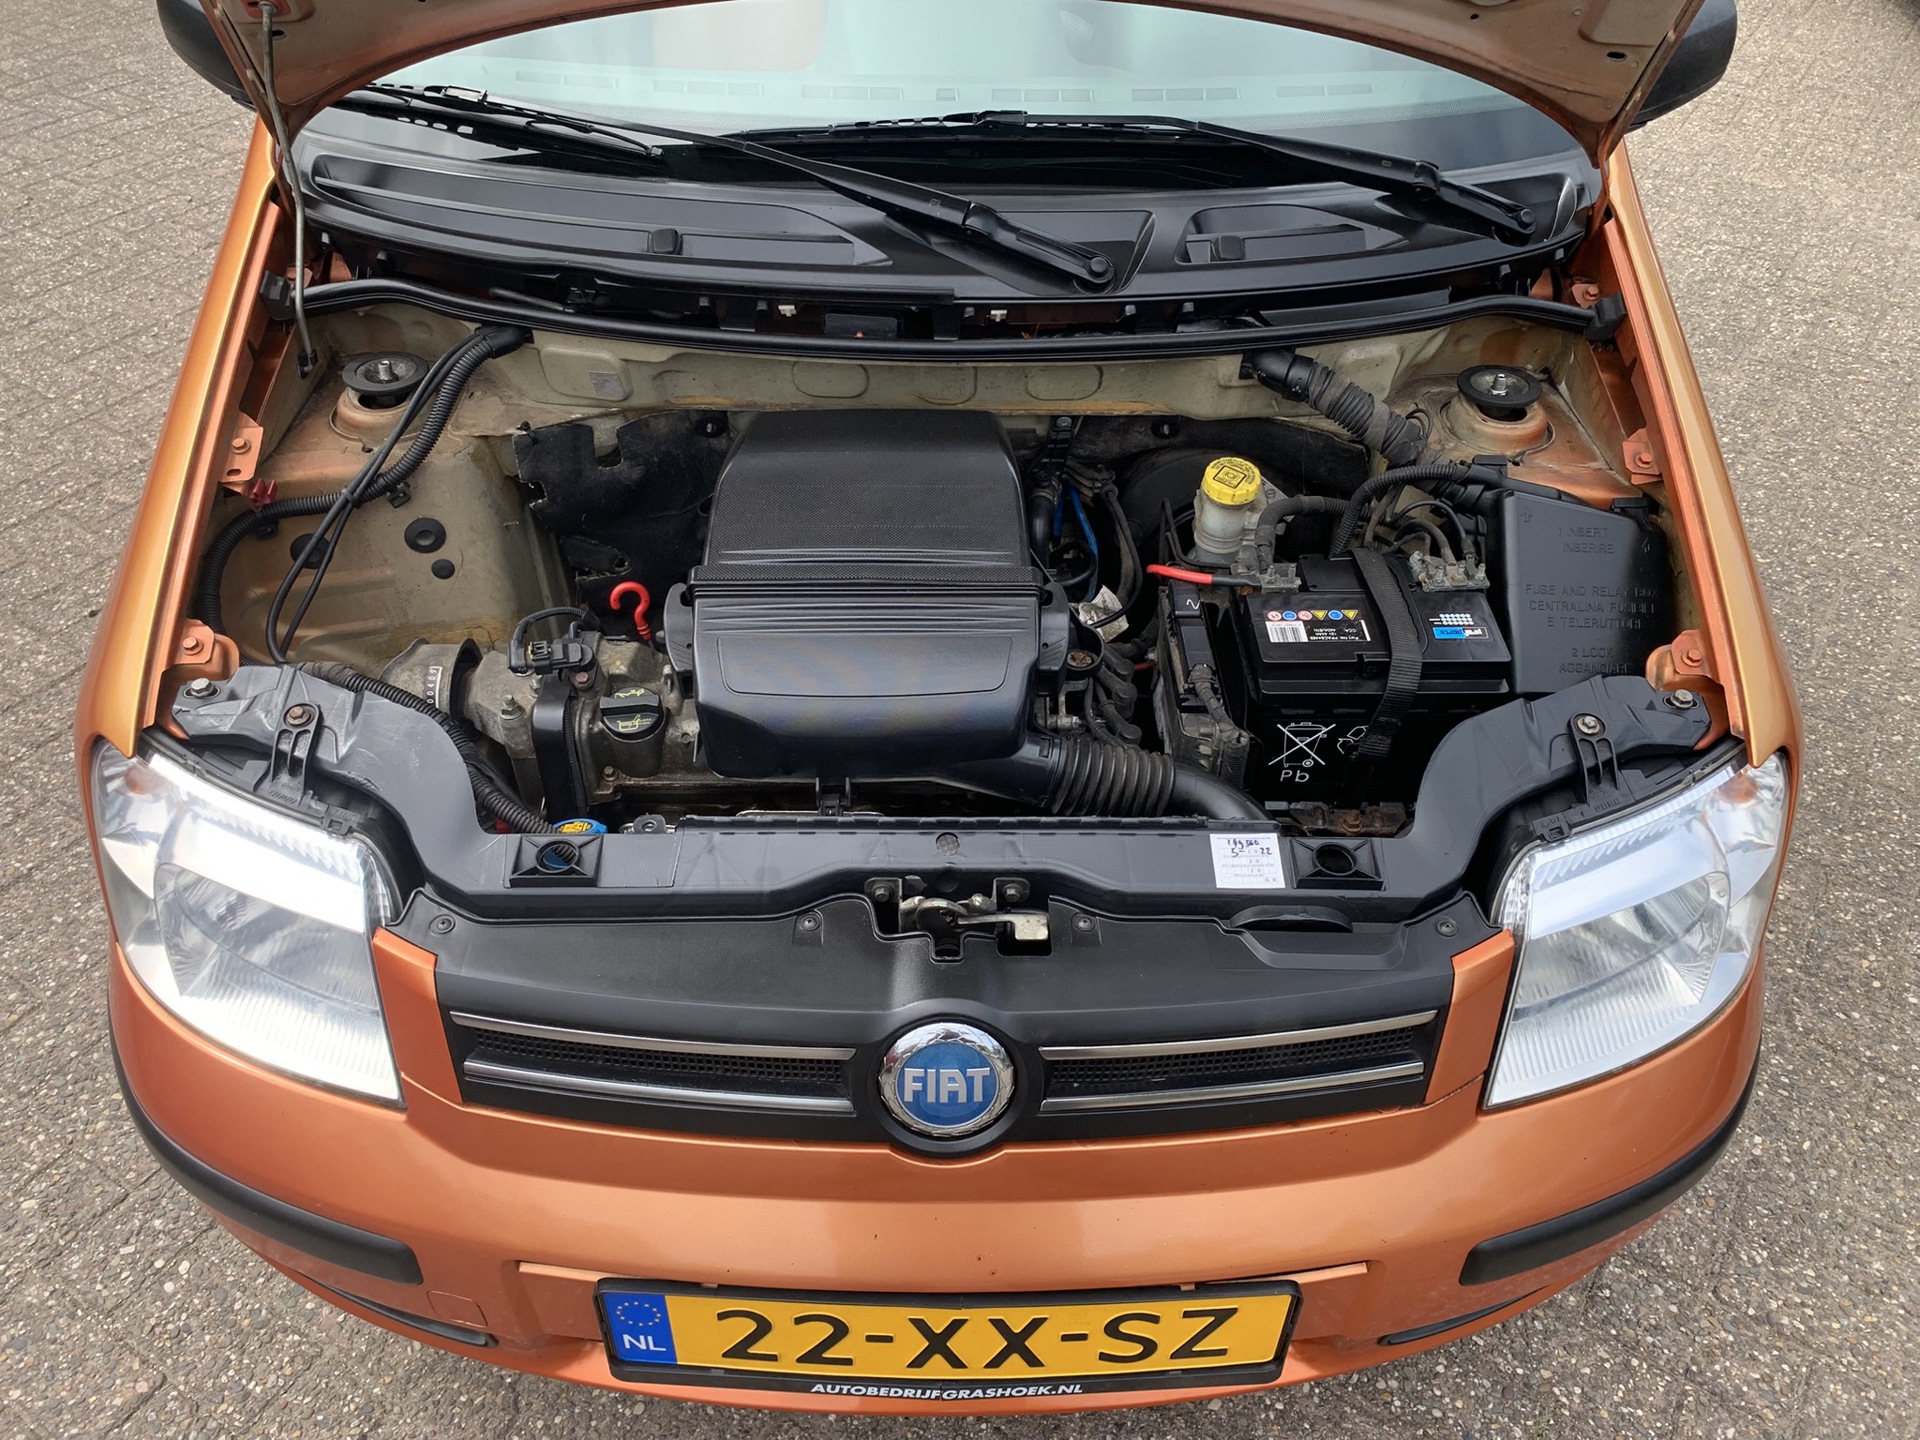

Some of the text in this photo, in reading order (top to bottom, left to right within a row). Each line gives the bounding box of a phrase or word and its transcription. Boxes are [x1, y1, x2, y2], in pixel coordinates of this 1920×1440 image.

[1566, 526, 1609, 538] INSERT
[1524, 583, 1556, 596] FUSE
[1561, 585, 1587, 597] AND
[1592, 586, 1629, 598] RELAY
[1528, 600, 1605, 613] CENTRALINA
[1546, 616, 1555, 627] E
[1570, 646, 1615, 659] 2 LOCK
[1280, 769, 1310, 783] Pb
[903, 1067, 991, 1104] FIAT
[622, 1333, 667, 1352] NL
[716, 1307, 1239, 1369] 22-XX-SZ
